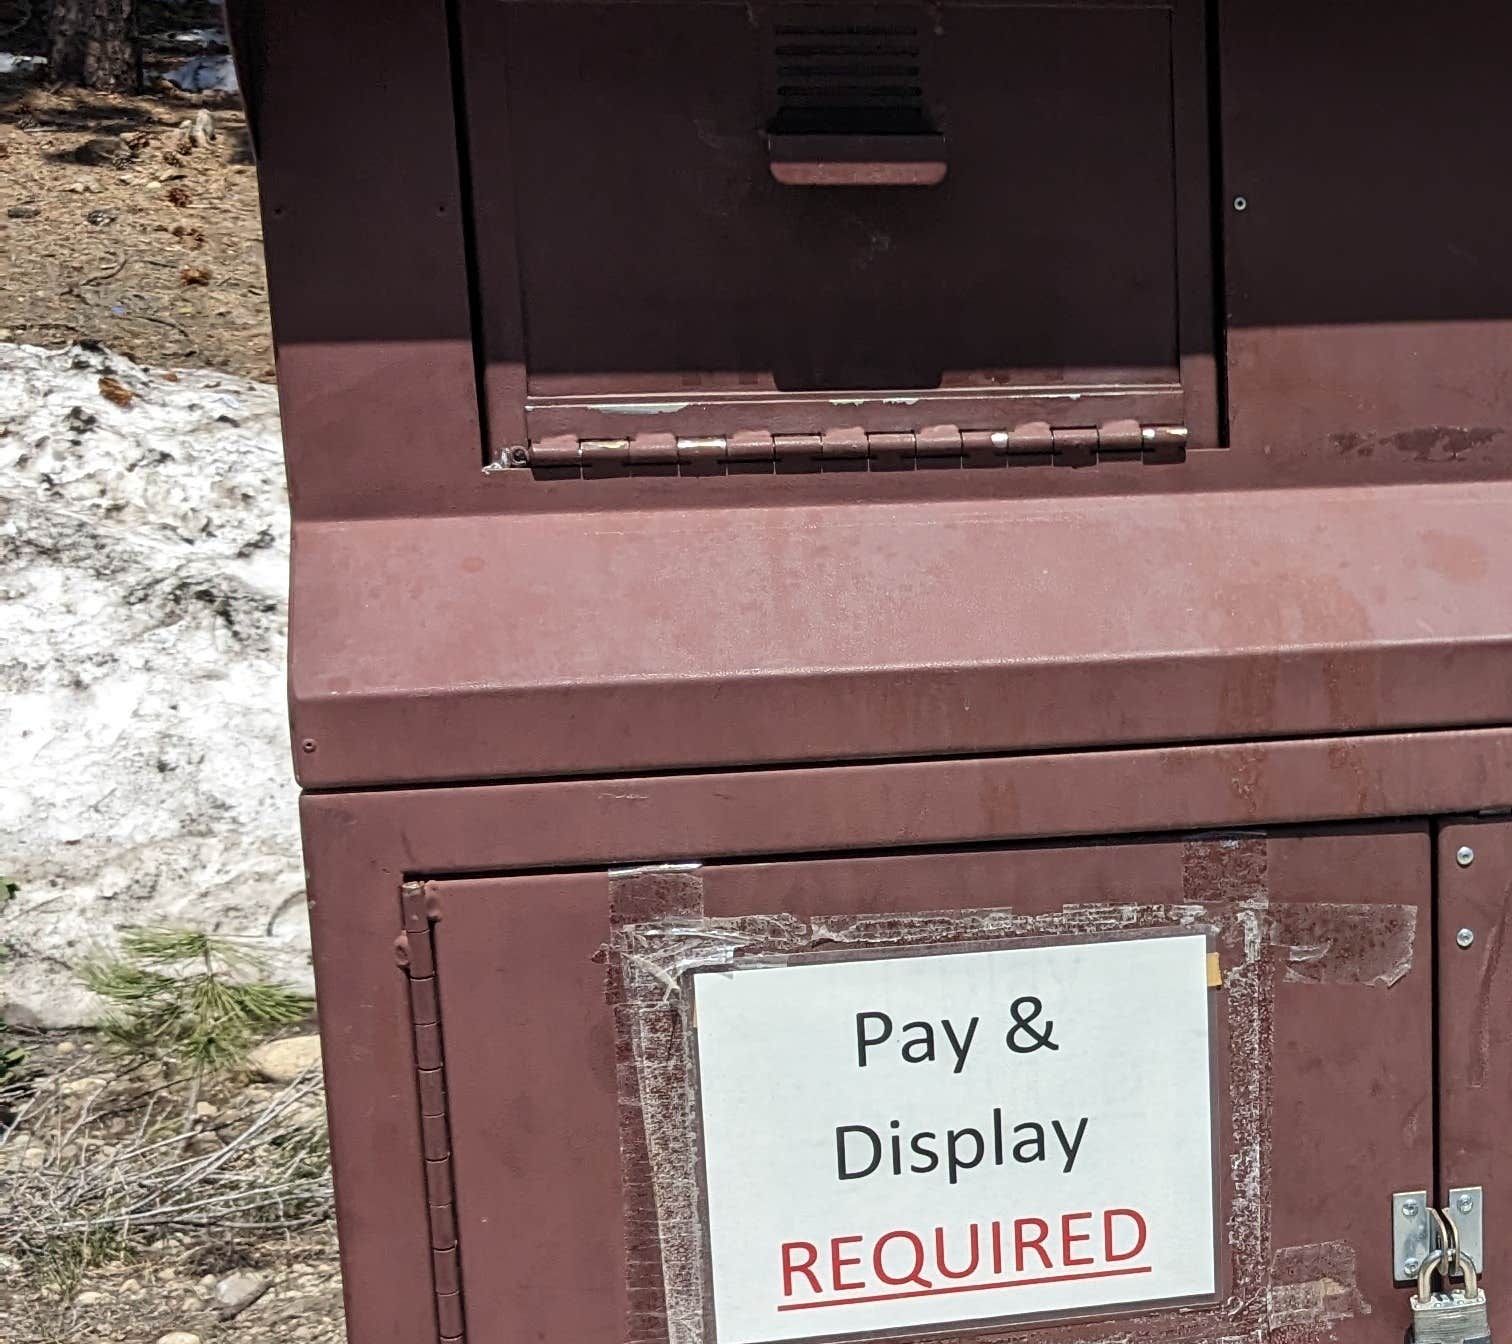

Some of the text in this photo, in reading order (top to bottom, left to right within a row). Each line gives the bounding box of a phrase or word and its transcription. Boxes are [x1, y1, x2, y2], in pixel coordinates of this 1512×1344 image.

[856, 996, 1059, 1074] Pay &
[836, 1107, 1089, 1185] Display
[782, 1208, 1149, 1298] REQUIRED
